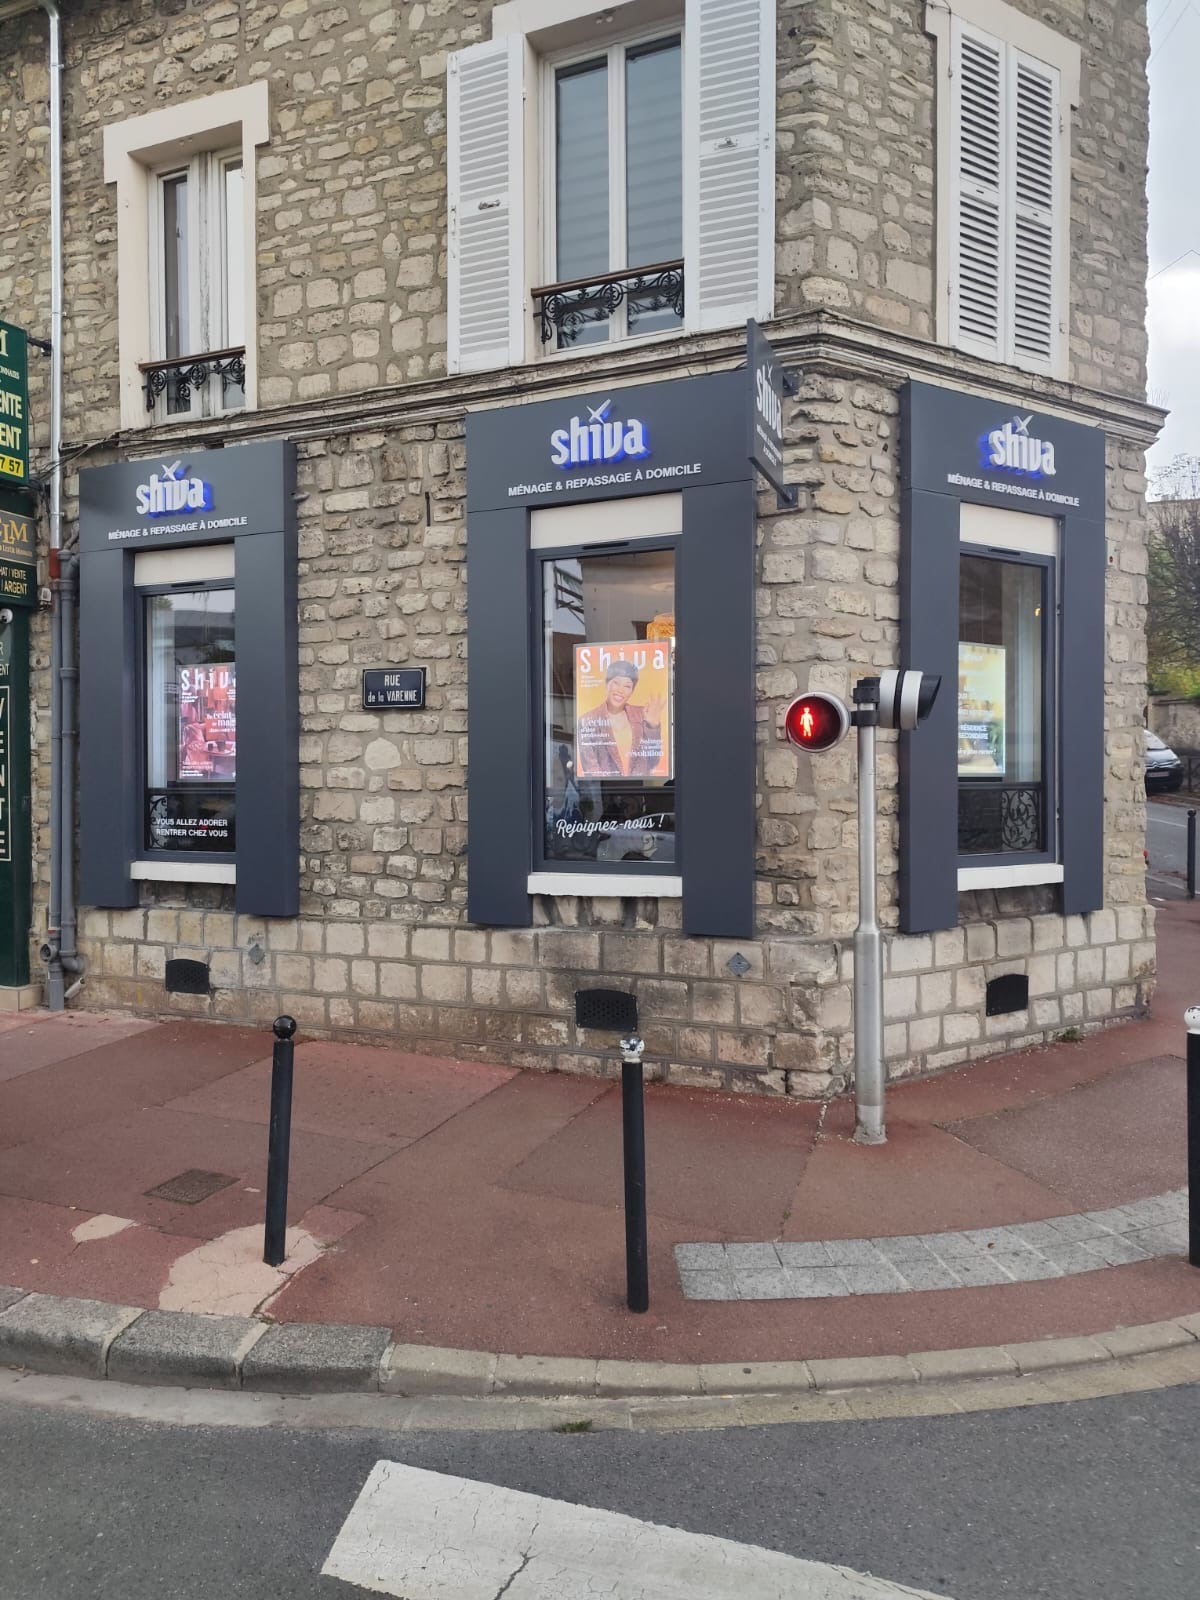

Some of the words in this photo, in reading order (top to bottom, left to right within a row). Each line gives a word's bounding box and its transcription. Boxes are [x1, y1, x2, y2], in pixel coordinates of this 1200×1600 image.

[551, 399, 647, 465] shiva
[988, 415, 1057, 475] shiva
[8, 459, 22, 474] 57
[136, 460, 206, 515] shiva
[508, 483, 553, 497] MÉNAGE
[555, 481, 563, 491] &
[566, 471, 632, 489] REPASSAGE
[634, 470, 643, 481] À
[645, 463, 702, 480] DOMICILE
[947, 473, 983, 489] MÉNAGE
[984, 480, 991, 490] &
[991, 481, 1038, 499] REPASSAGE
[1038, 488, 1045, 500] À
[1045, 491, 1080, 507] DOMICILE
[108, 527, 142, 540] MÉNAGE
[142, 528, 149, 537] &
[150, 521, 198, 536] REPASSAGE
[199, 520, 207, 530] À
[207, 516, 248, 530] DOMICILE
[4, 581, 28, 595] ARGENT
[580, 647, 665, 674] Shiva
[384, 674, 401, 687] RUE
[367, 691, 376, 703] de
[386, 690, 418, 702] VARENNE
[155, 818, 175, 826] VOUS
[176, 818, 198, 826] ALLEZ
[198, 819, 228, 827] ADORER
[155, 828, 187, 836] RENTRER
[188, 829, 207, 837] CHEZ
[208, 829, 228, 837] VOUS
[556, 818, 656, 839] Rejoignez-nous
[658, 813, 665, 828] !
